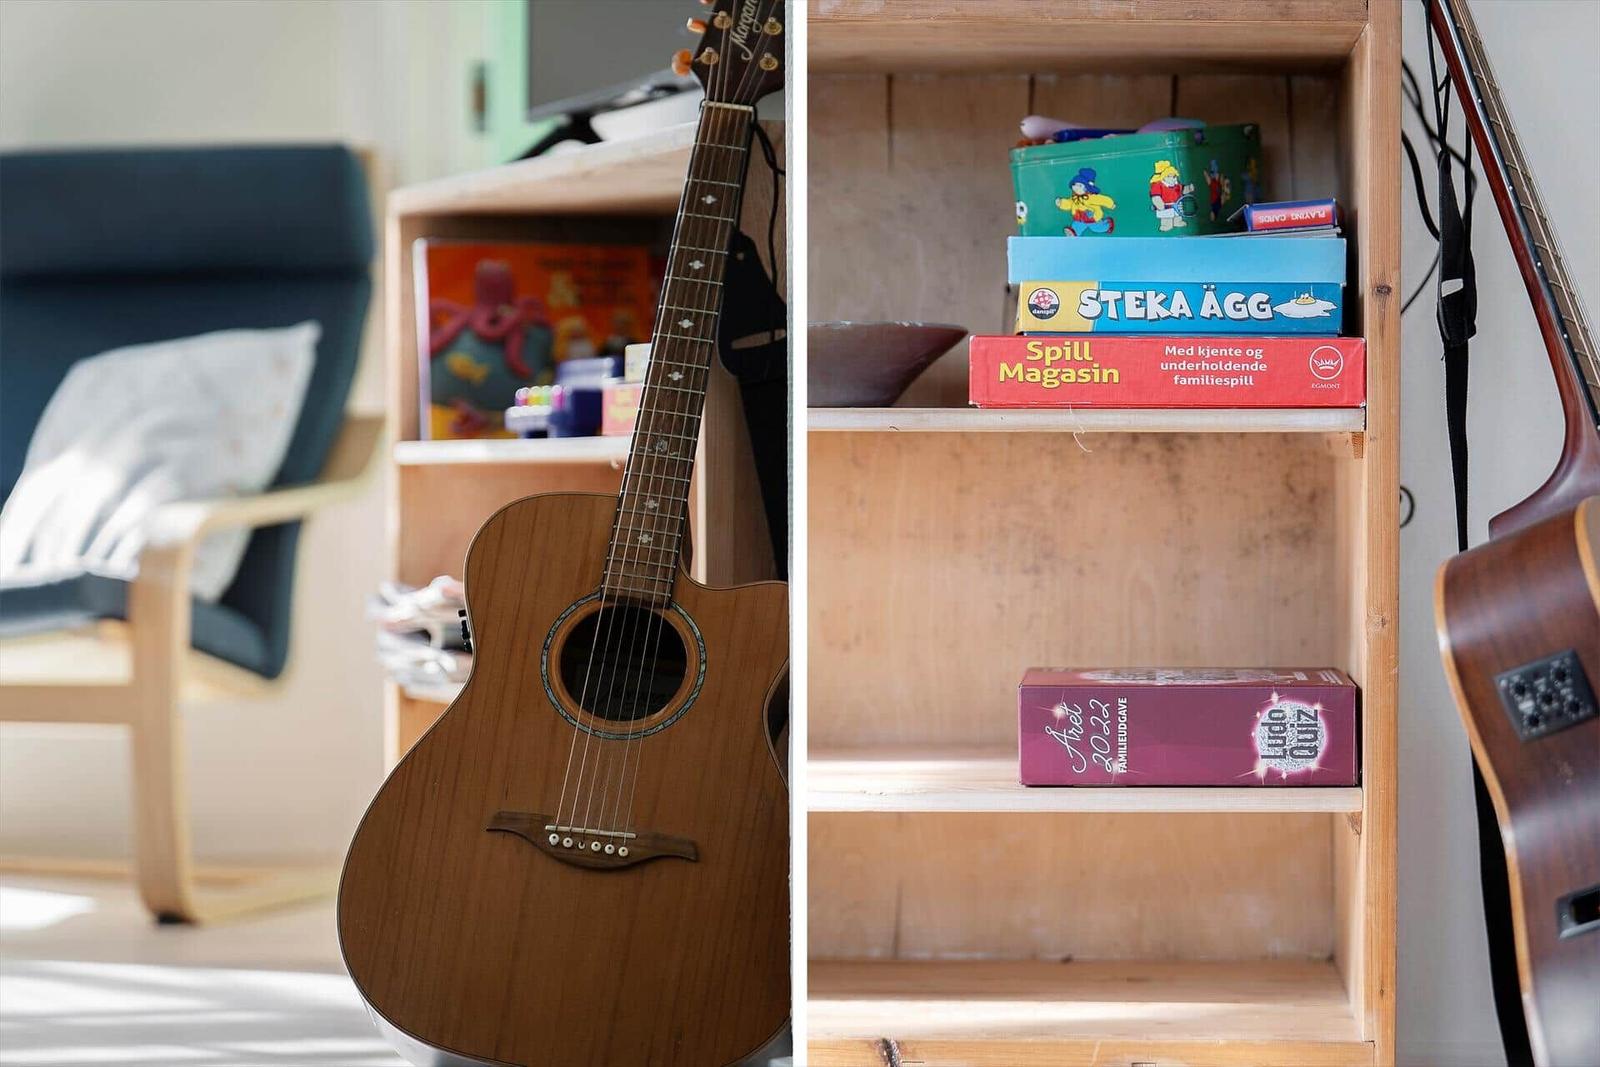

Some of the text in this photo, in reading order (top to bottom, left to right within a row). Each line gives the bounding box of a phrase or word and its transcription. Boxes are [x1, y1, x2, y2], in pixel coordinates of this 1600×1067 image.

[1258, 209, 1326, 223] PLAYING CARDS
[1077, 283, 1275, 321] STEKA ÄGG
[1026, 340, 1093, 366] Spill
[1160, 360, 1267, 372] underholdende
[1164, 345, 1263, 359] Med kjente og
[998, 363, 1120, 389] Magasin
[1173, 374, 1254, 387] familiespill
[1045, 702, 1087, 773] Året
[1089, 698, 1113, 773] 2022
[1117, 697, 1128, 773] FAMILIEUDGAVE
[1260, 709, 1288, 760] Ludo
[1289, 709, 1319, 760] Quiz
